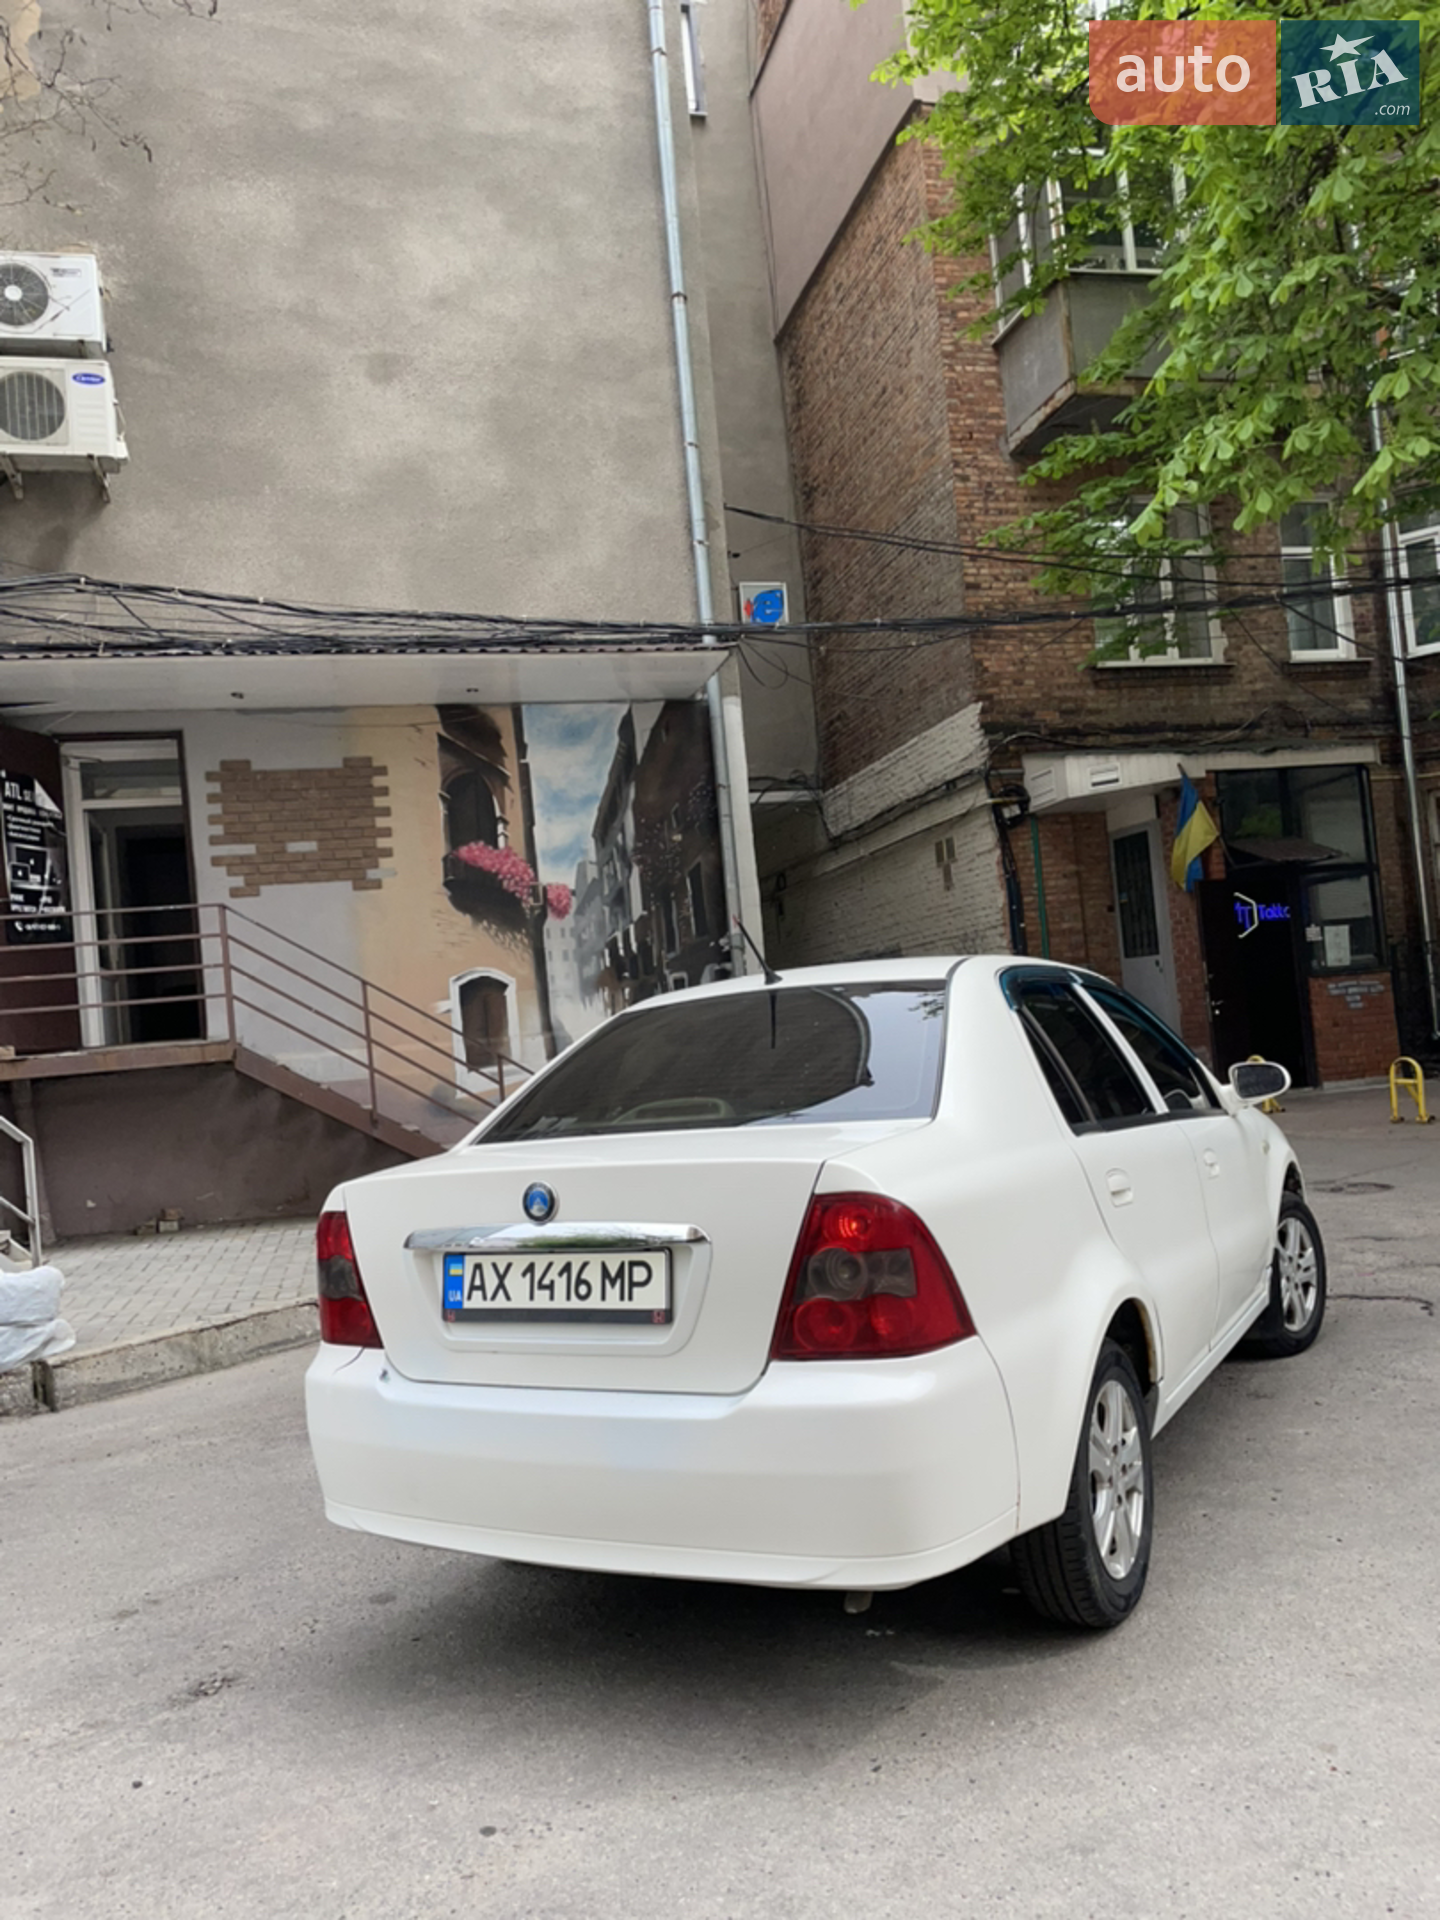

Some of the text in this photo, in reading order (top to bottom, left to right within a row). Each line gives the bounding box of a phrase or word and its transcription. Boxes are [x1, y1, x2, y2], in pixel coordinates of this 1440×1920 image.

[466, 1260, 654, 1302] AX 1416 MP
[448, 1290, 462, 1302] UA
